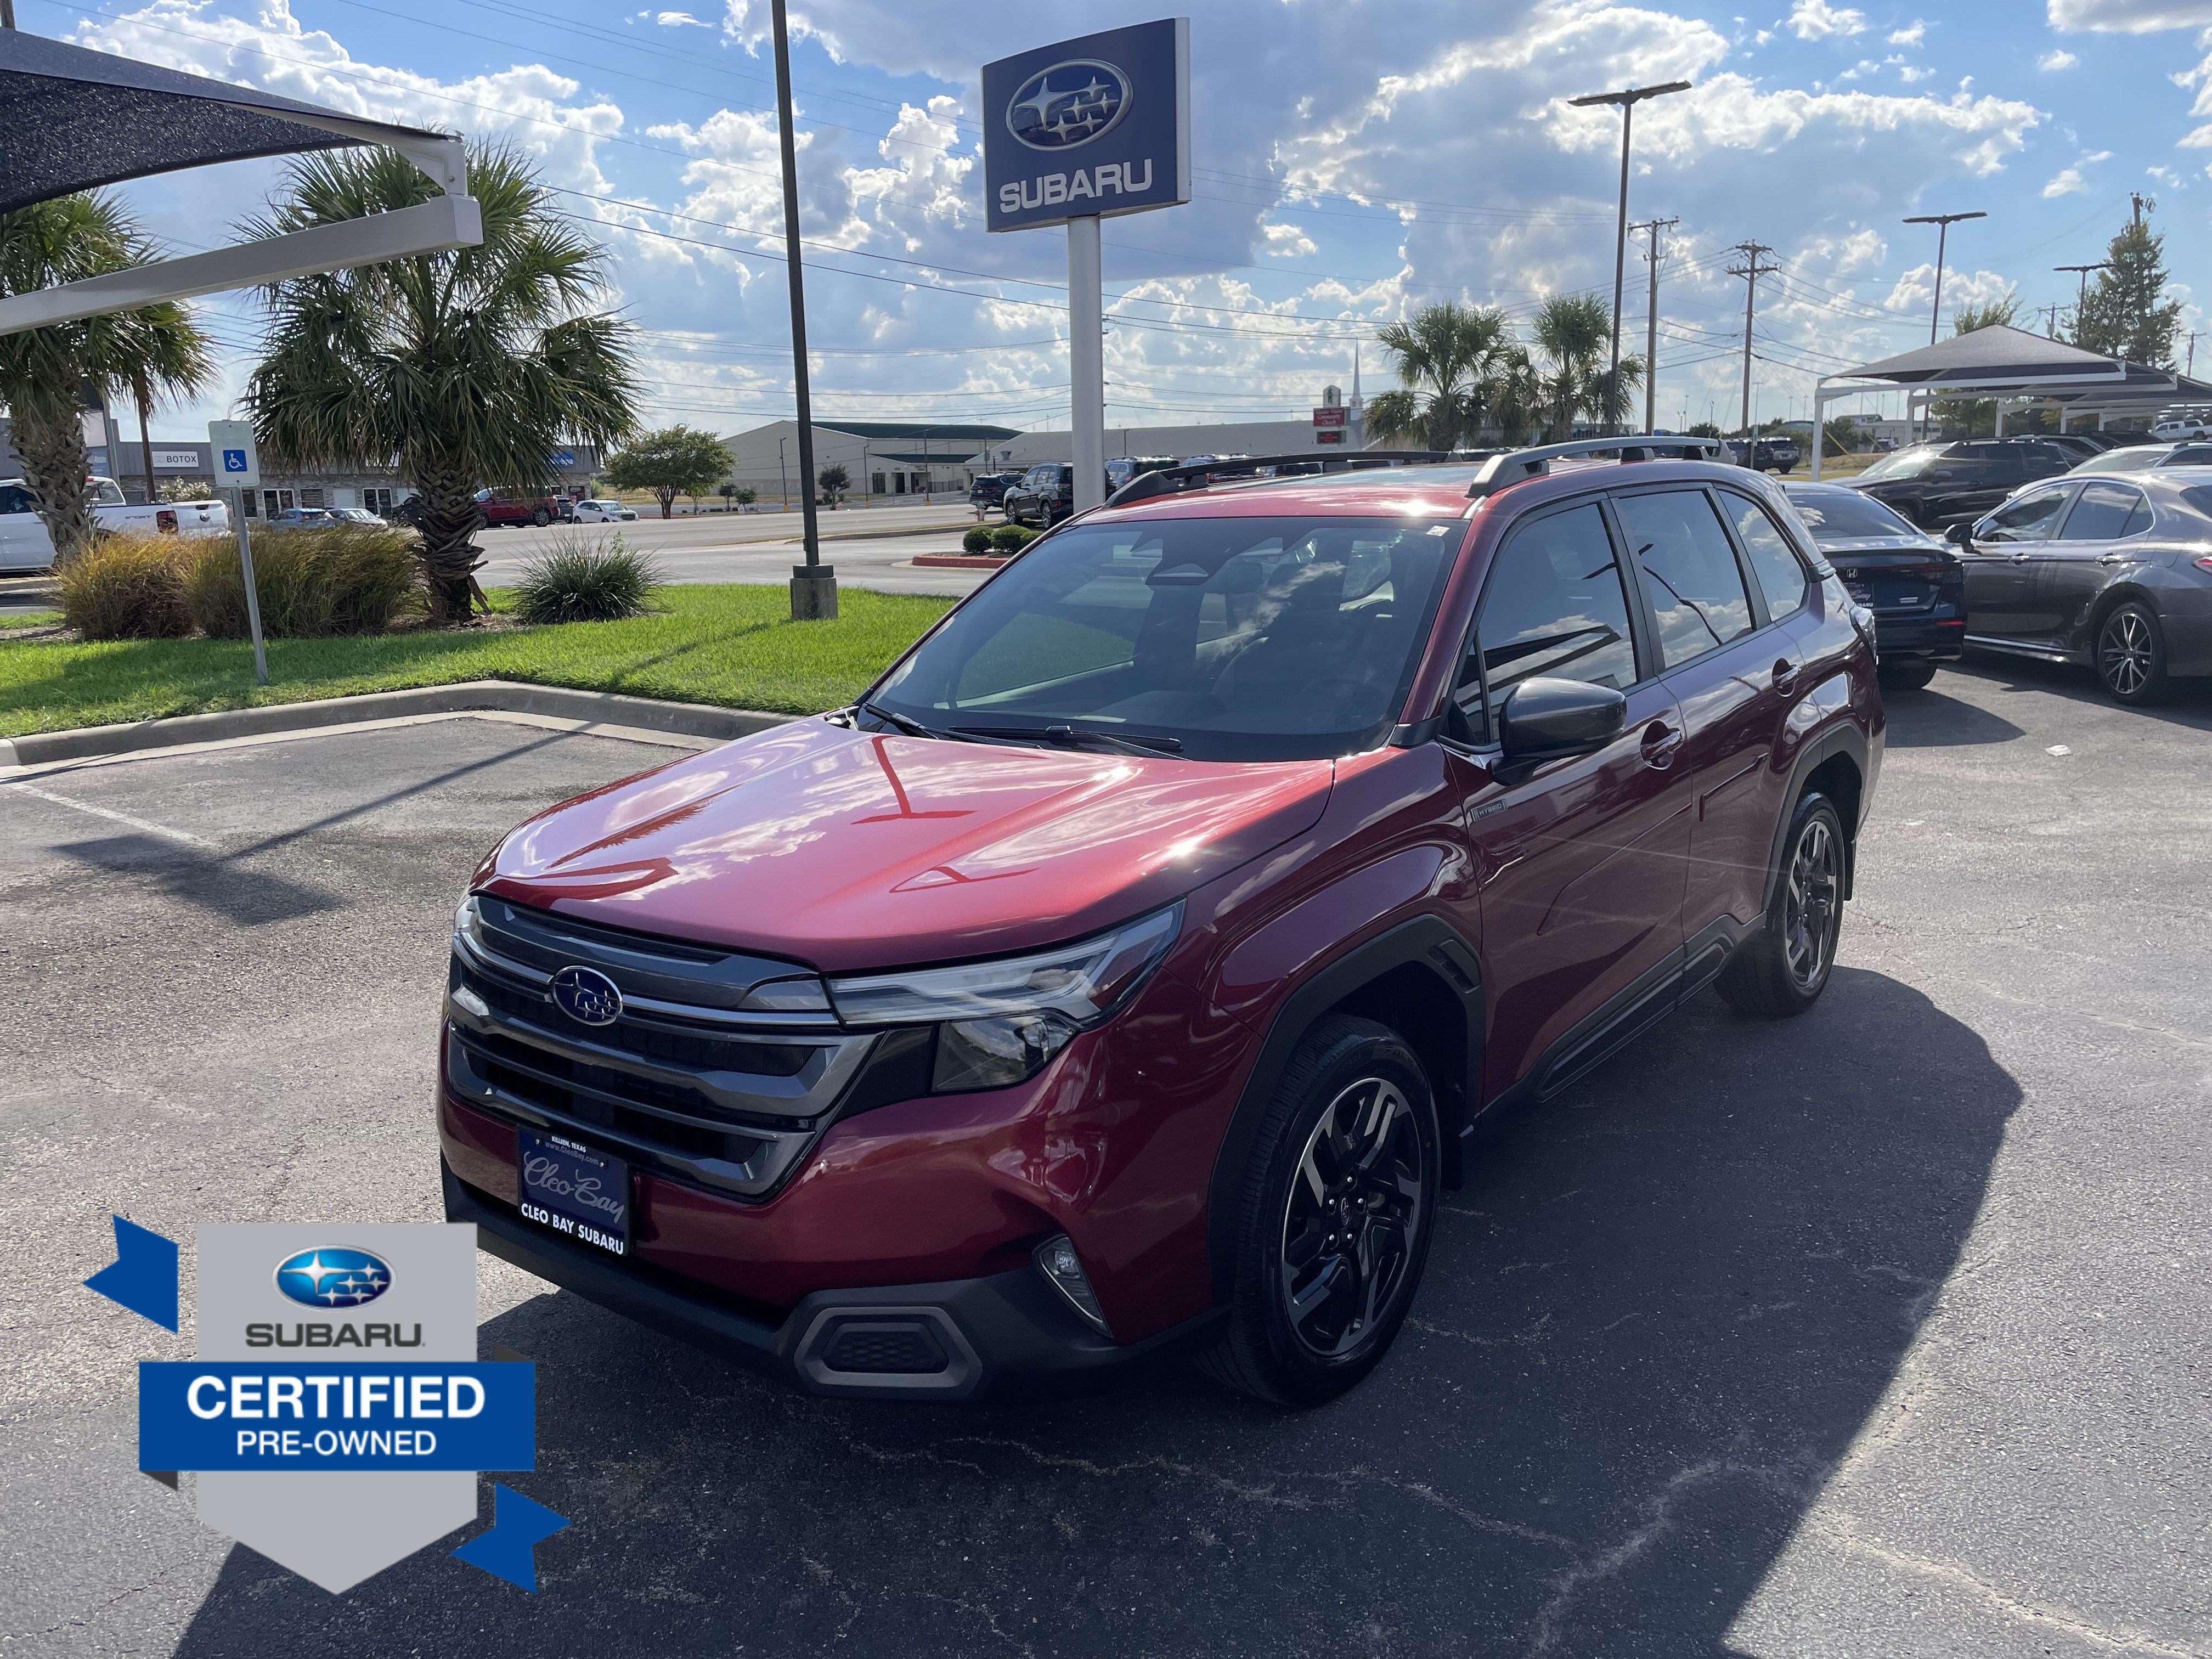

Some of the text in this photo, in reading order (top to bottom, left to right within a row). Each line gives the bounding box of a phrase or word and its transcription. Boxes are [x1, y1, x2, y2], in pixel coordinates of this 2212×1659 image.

[999, 159, 1152, 213] SUBARU
[1479, 804, 1502, 816] HYBRID
[545, 1142, 599, 1165] www.CleoBay.com
[551, 1136, 586, 1153] KILLEEN, TEXAS
[523, 1151, 624, 1223] Cleo Bay
[521, 1203, 624, 1255] CLEO BAY SUBARU
